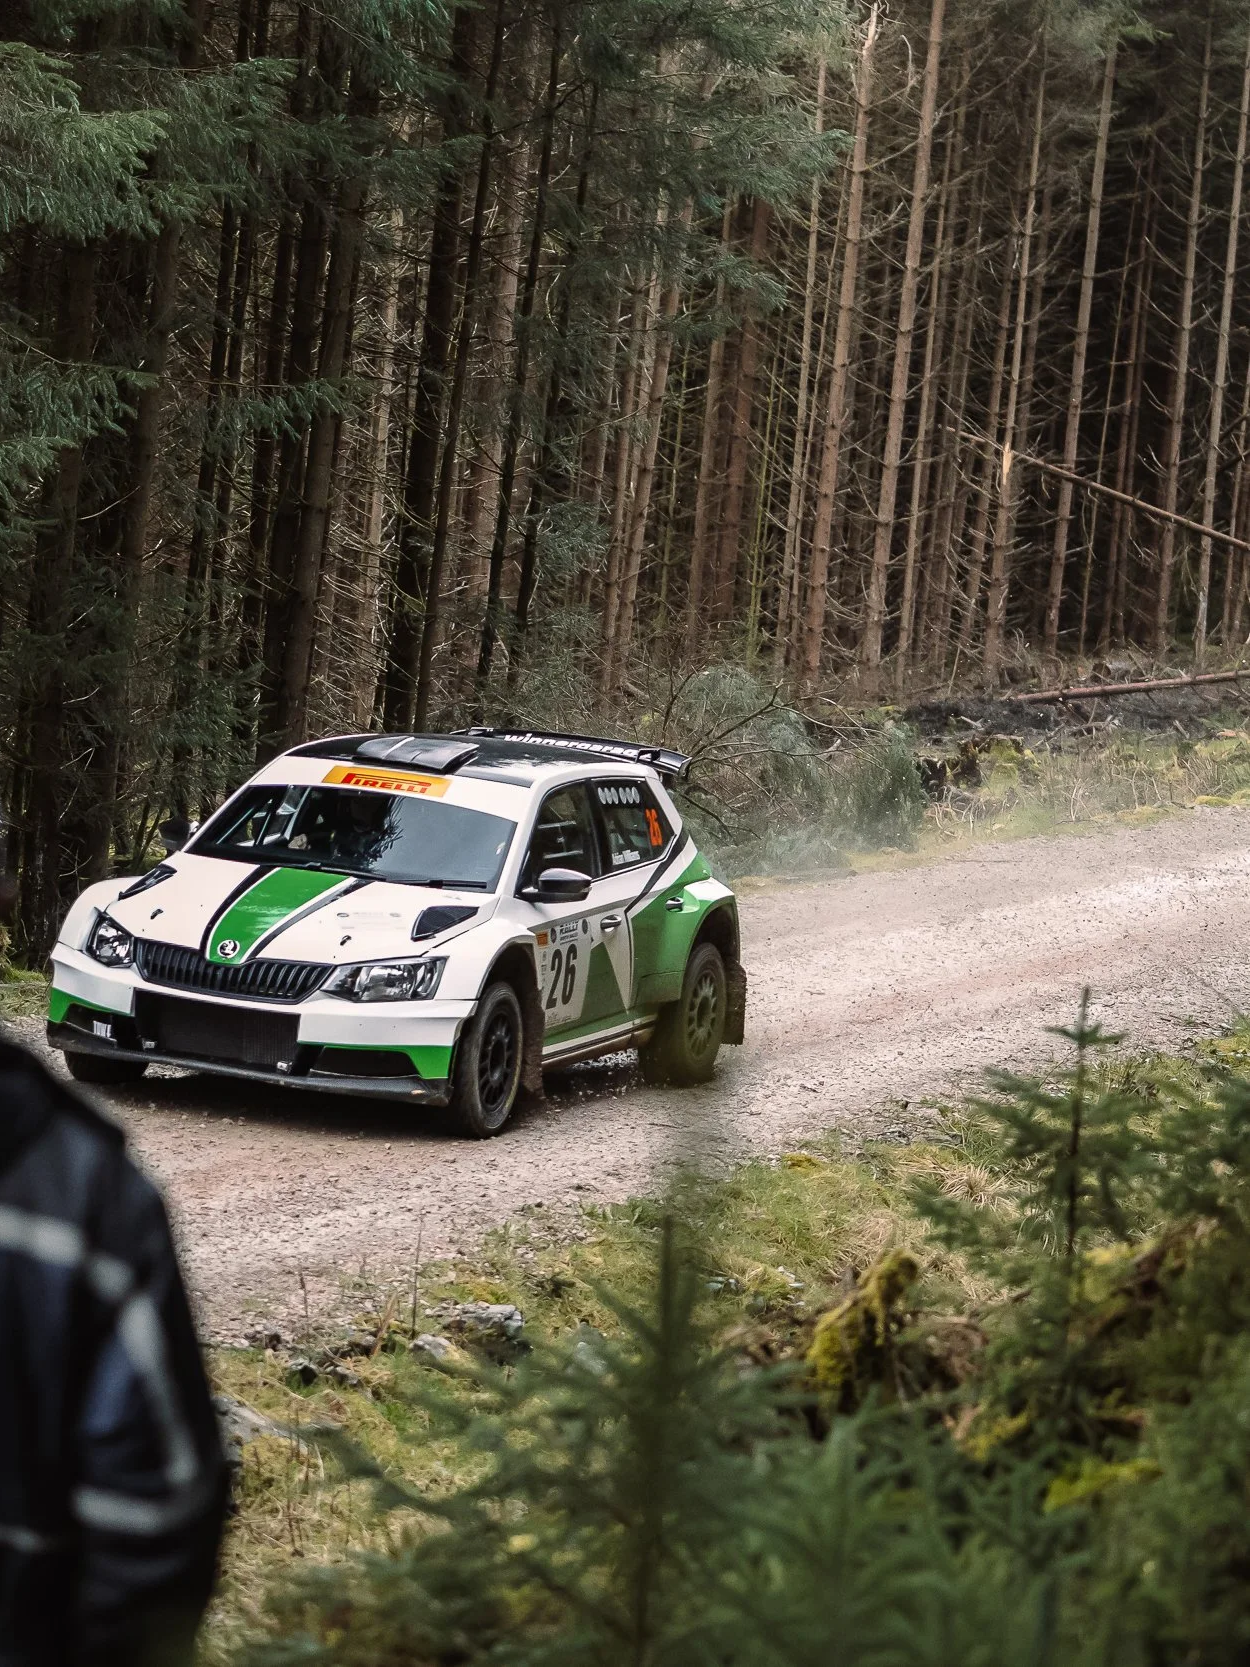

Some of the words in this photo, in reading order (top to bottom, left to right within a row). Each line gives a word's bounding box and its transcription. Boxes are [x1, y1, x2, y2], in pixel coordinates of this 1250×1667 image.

[341, 772, 432, 794] PIRELLI
[646, 809, 662, 846] 26
[546, 943, 577, 1010] 26
